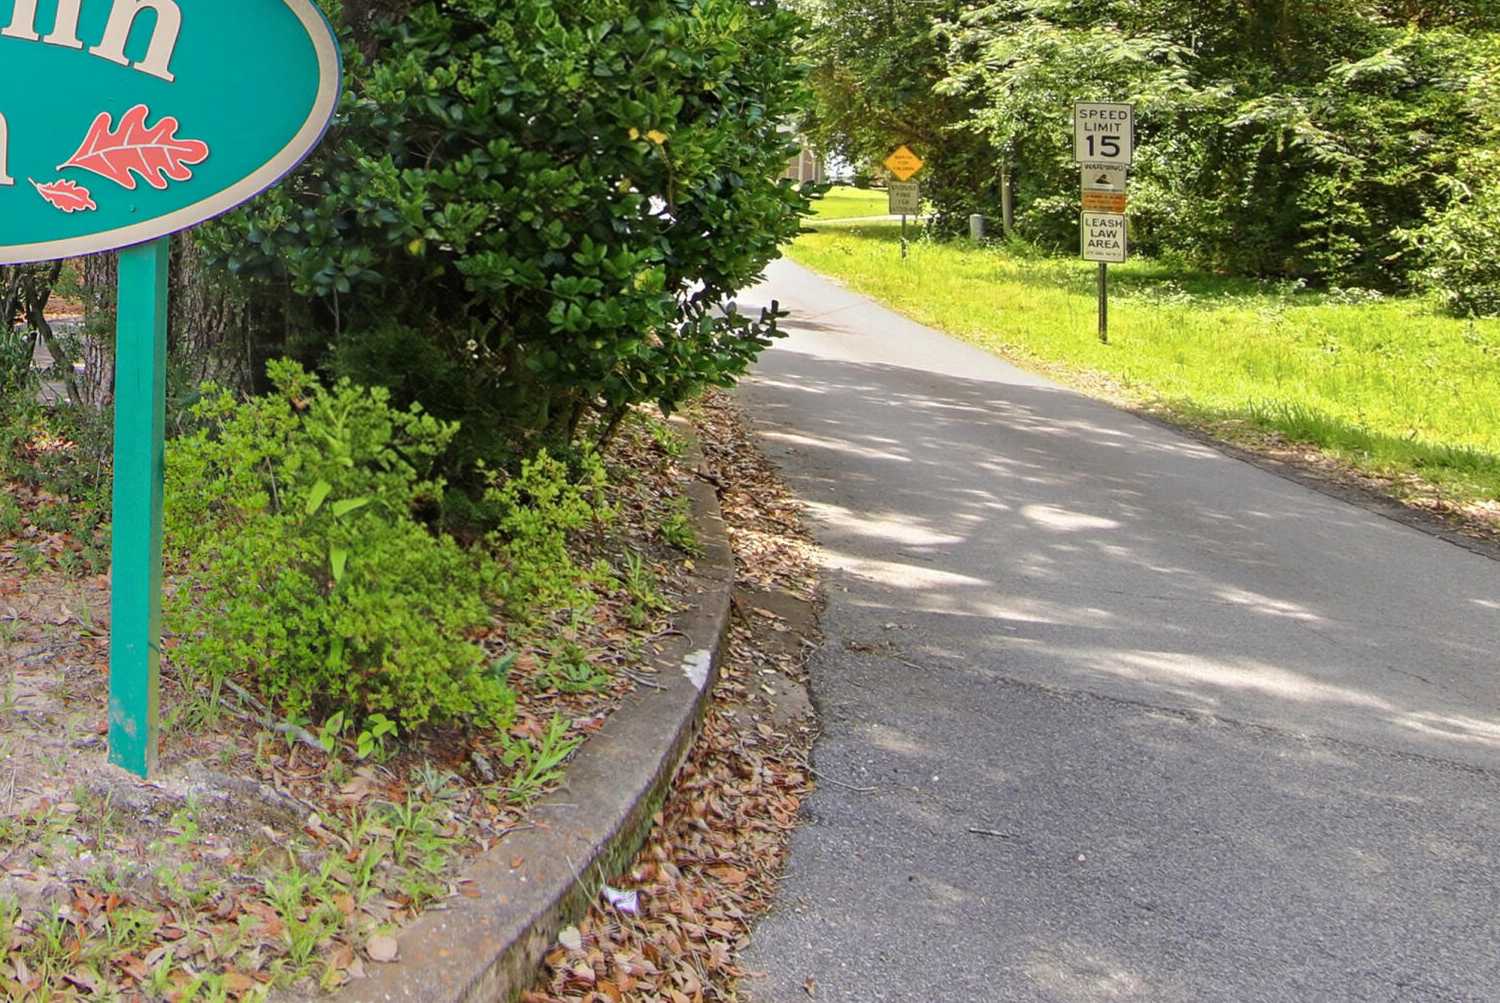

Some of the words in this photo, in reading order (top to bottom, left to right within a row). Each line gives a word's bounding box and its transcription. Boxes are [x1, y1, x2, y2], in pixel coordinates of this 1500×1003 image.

[1079, 109, 1128, 120] SPEED
[1084, 122, 1122, 132] LIMIT
[1086, 135, 1120, 158] 15
[1085, 218, 1123, 229] LEASH
[1090, 228, 1117, 238] LAW
[1087, 239, 1120, 249] AREA
